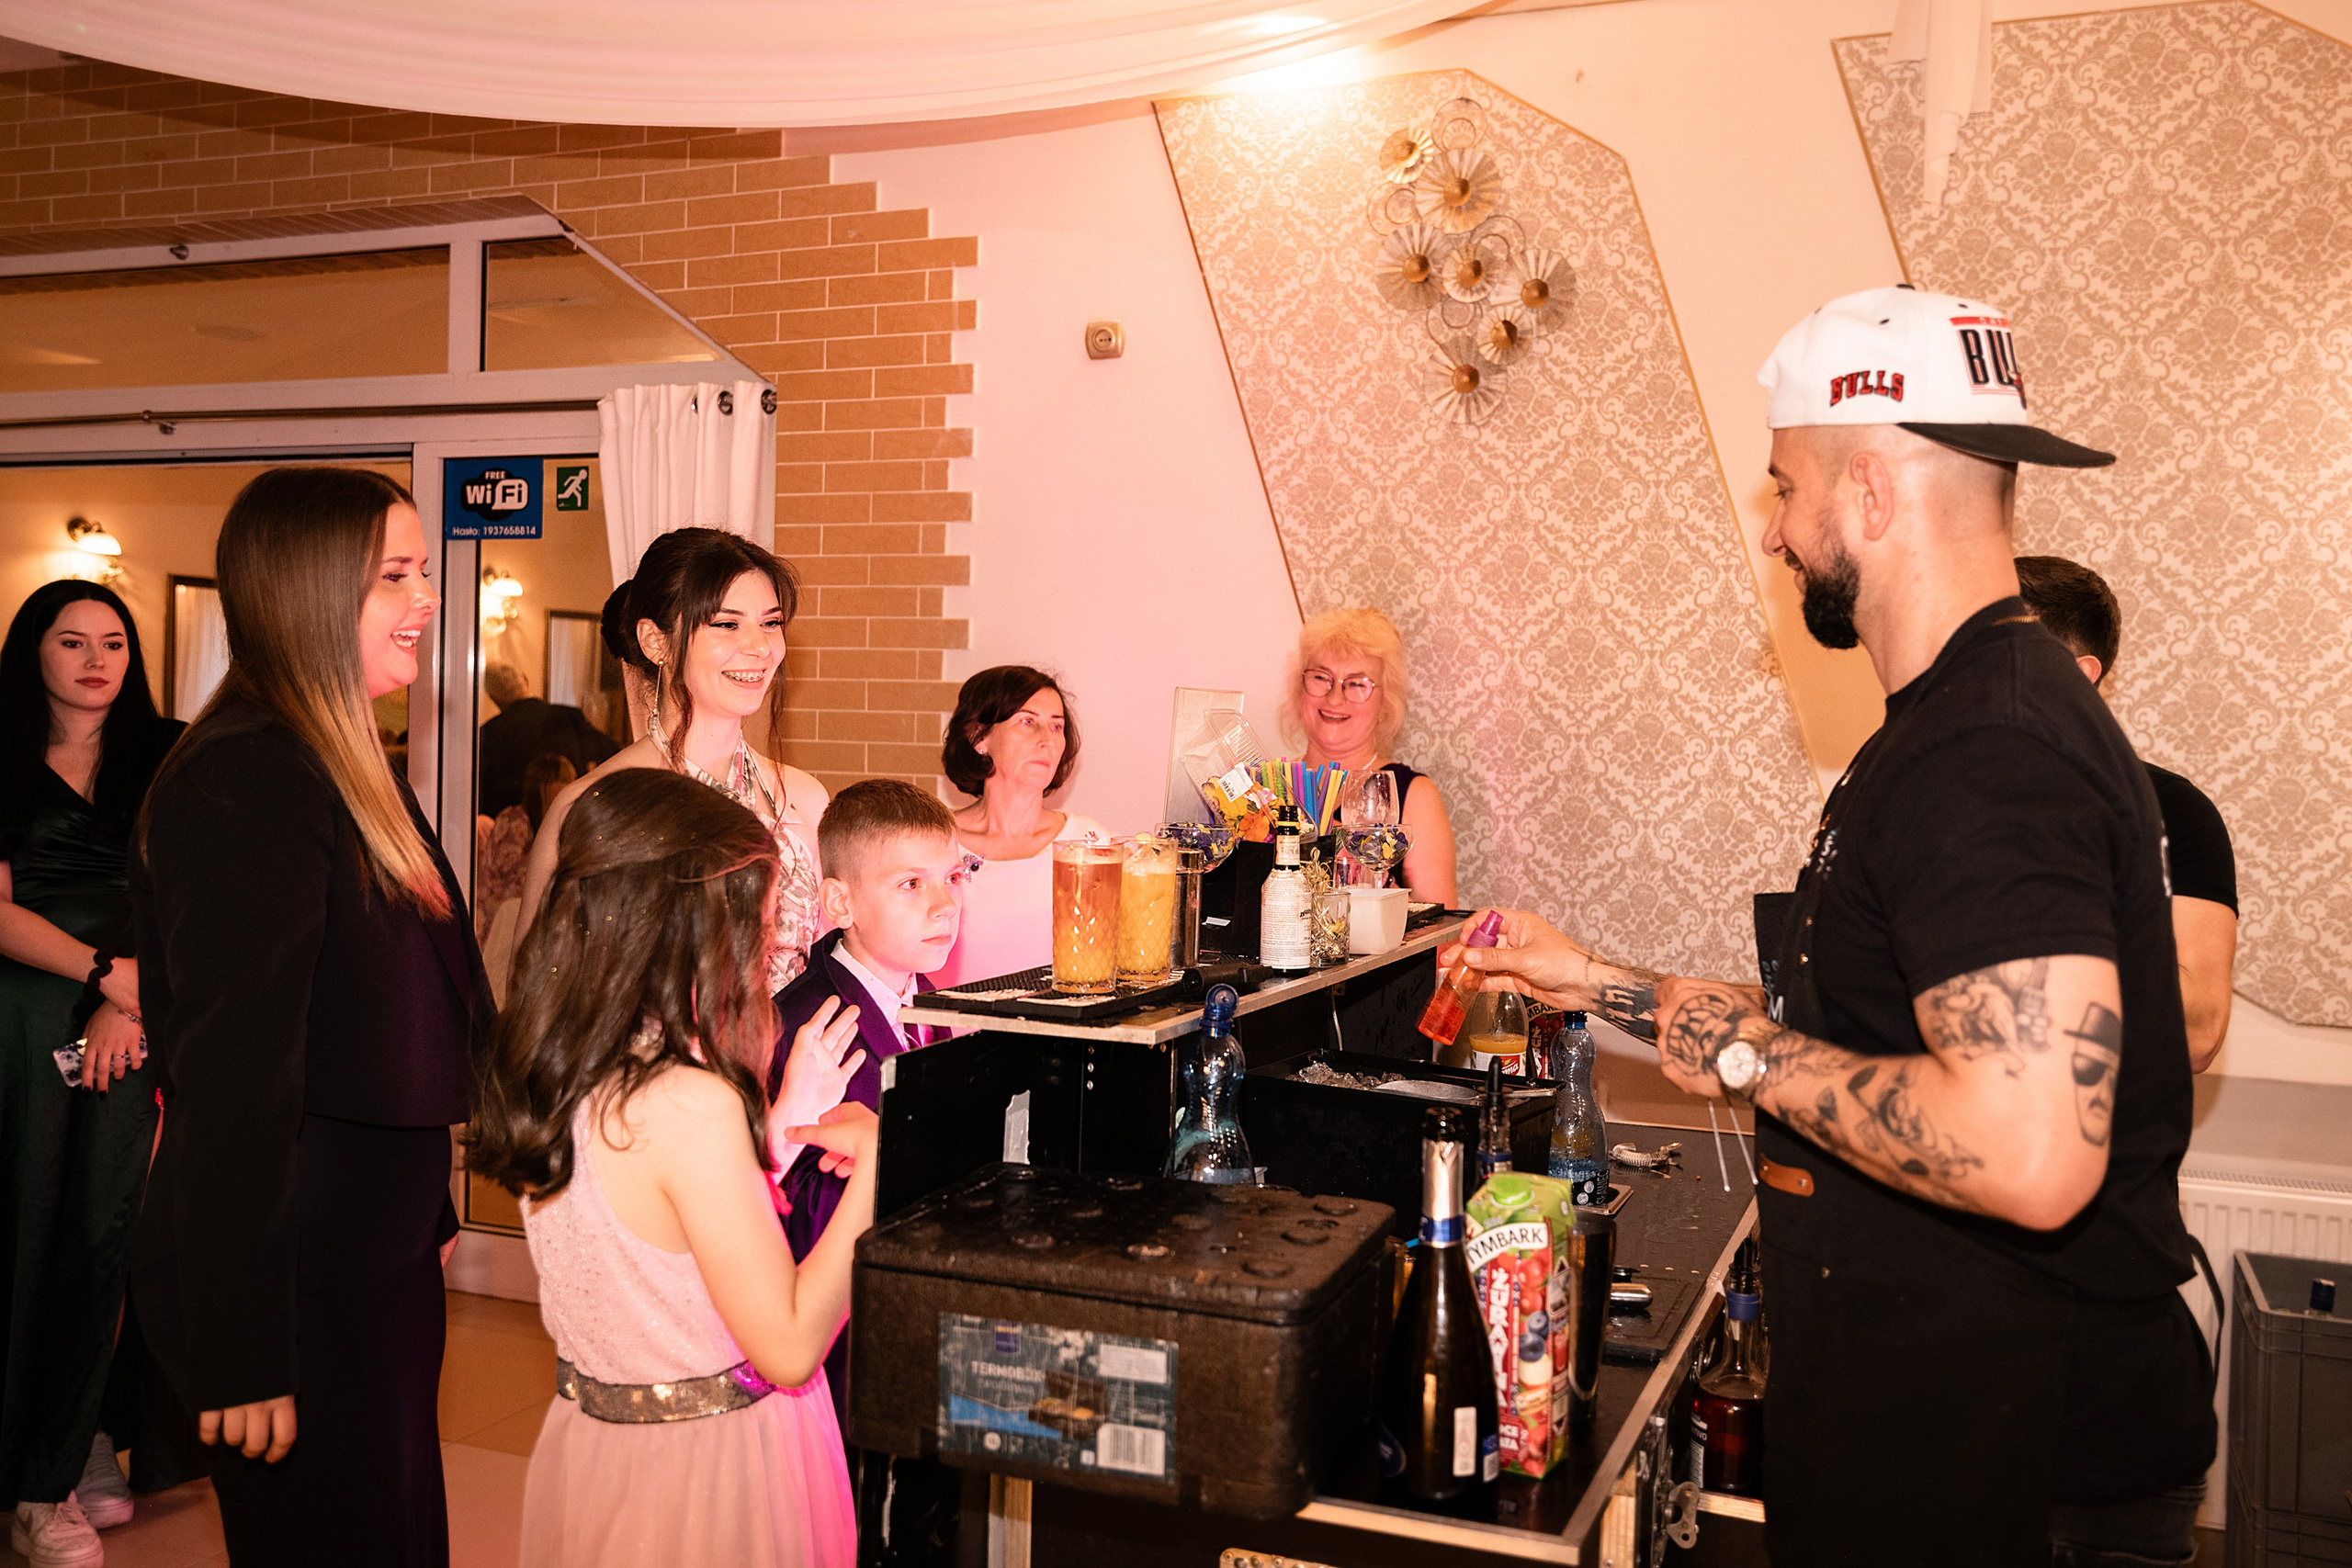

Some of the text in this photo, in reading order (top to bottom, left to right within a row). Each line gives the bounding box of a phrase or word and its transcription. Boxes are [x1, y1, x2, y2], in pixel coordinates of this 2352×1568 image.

[1830, 370, 1904, 407] BULLS
[485, 470, 505, 479] FREE
[483, 525, 537, 536] 1937658814
